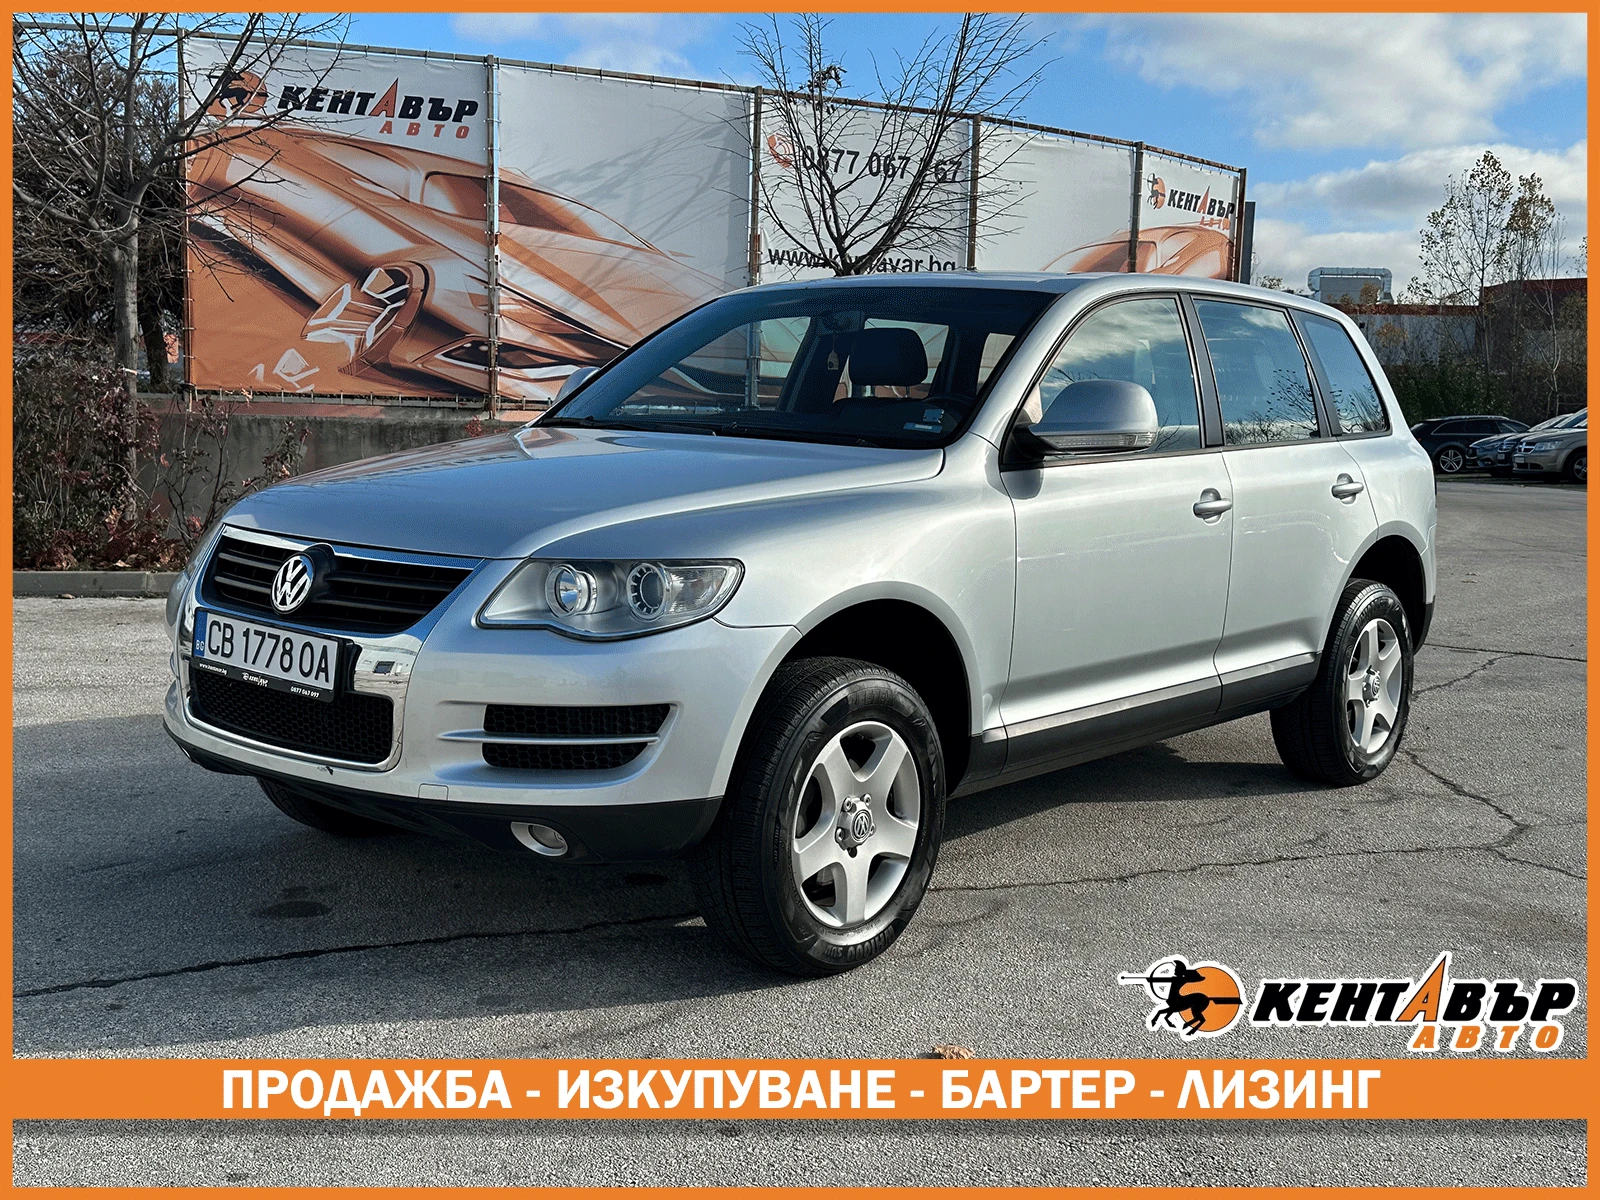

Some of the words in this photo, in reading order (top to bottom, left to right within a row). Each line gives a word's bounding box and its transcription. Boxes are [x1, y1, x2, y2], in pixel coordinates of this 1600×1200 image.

[277, 78, 479, 122] КЕНТАВЪР
[379, 120, 470, 139] АВТО
[868, 151, 911, 180] 067
[1167, 186, 1235, 218] КЕНТАВЪР
[195, 640, 205, 651] BG
[208, 620, 234, 658] CB
[242, 627, 293, 673] 1778
[299, 641, 329, 683] OA
